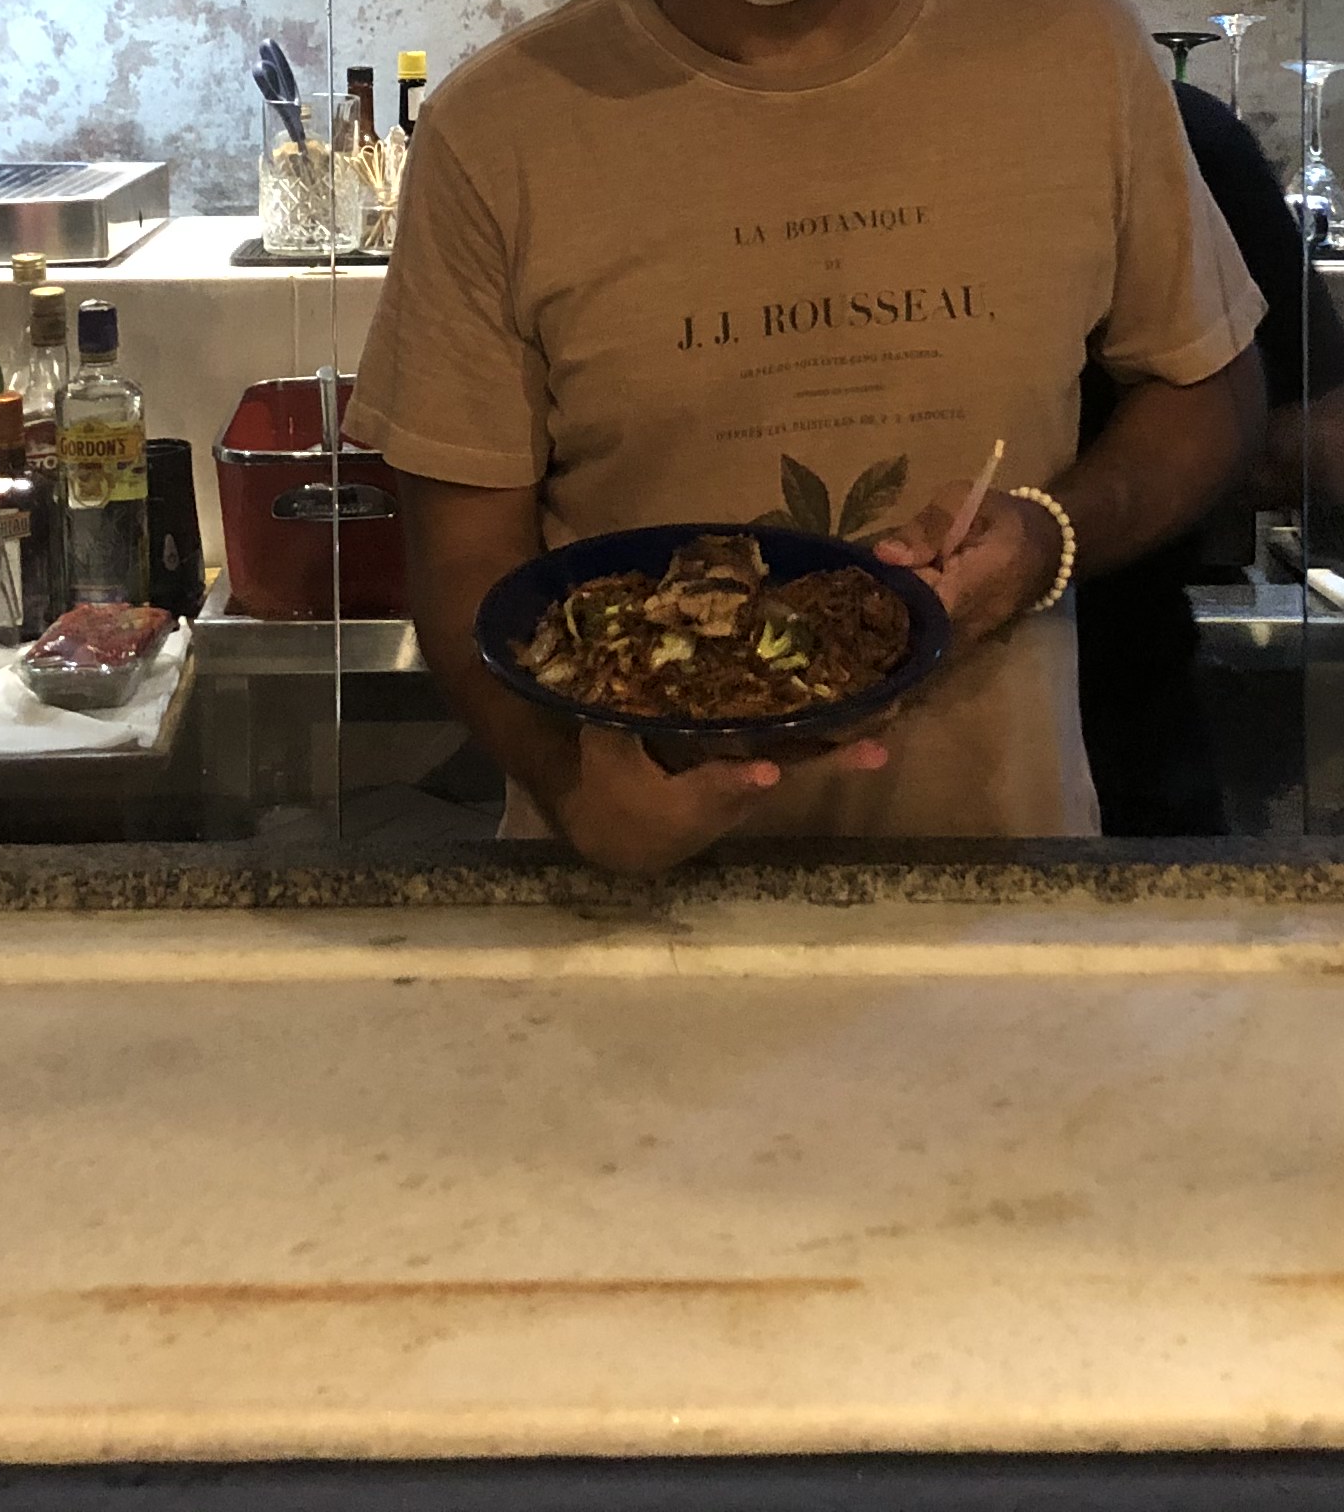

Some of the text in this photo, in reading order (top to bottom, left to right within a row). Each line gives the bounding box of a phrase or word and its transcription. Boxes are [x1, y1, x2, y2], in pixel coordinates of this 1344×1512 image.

[733, 204, 930, 246] LA BOTANIQUE
[677, 316, 704, 351] J.
[713, 310, 740, 346] J.
[60, 436, 127, 458] GORDON'S
